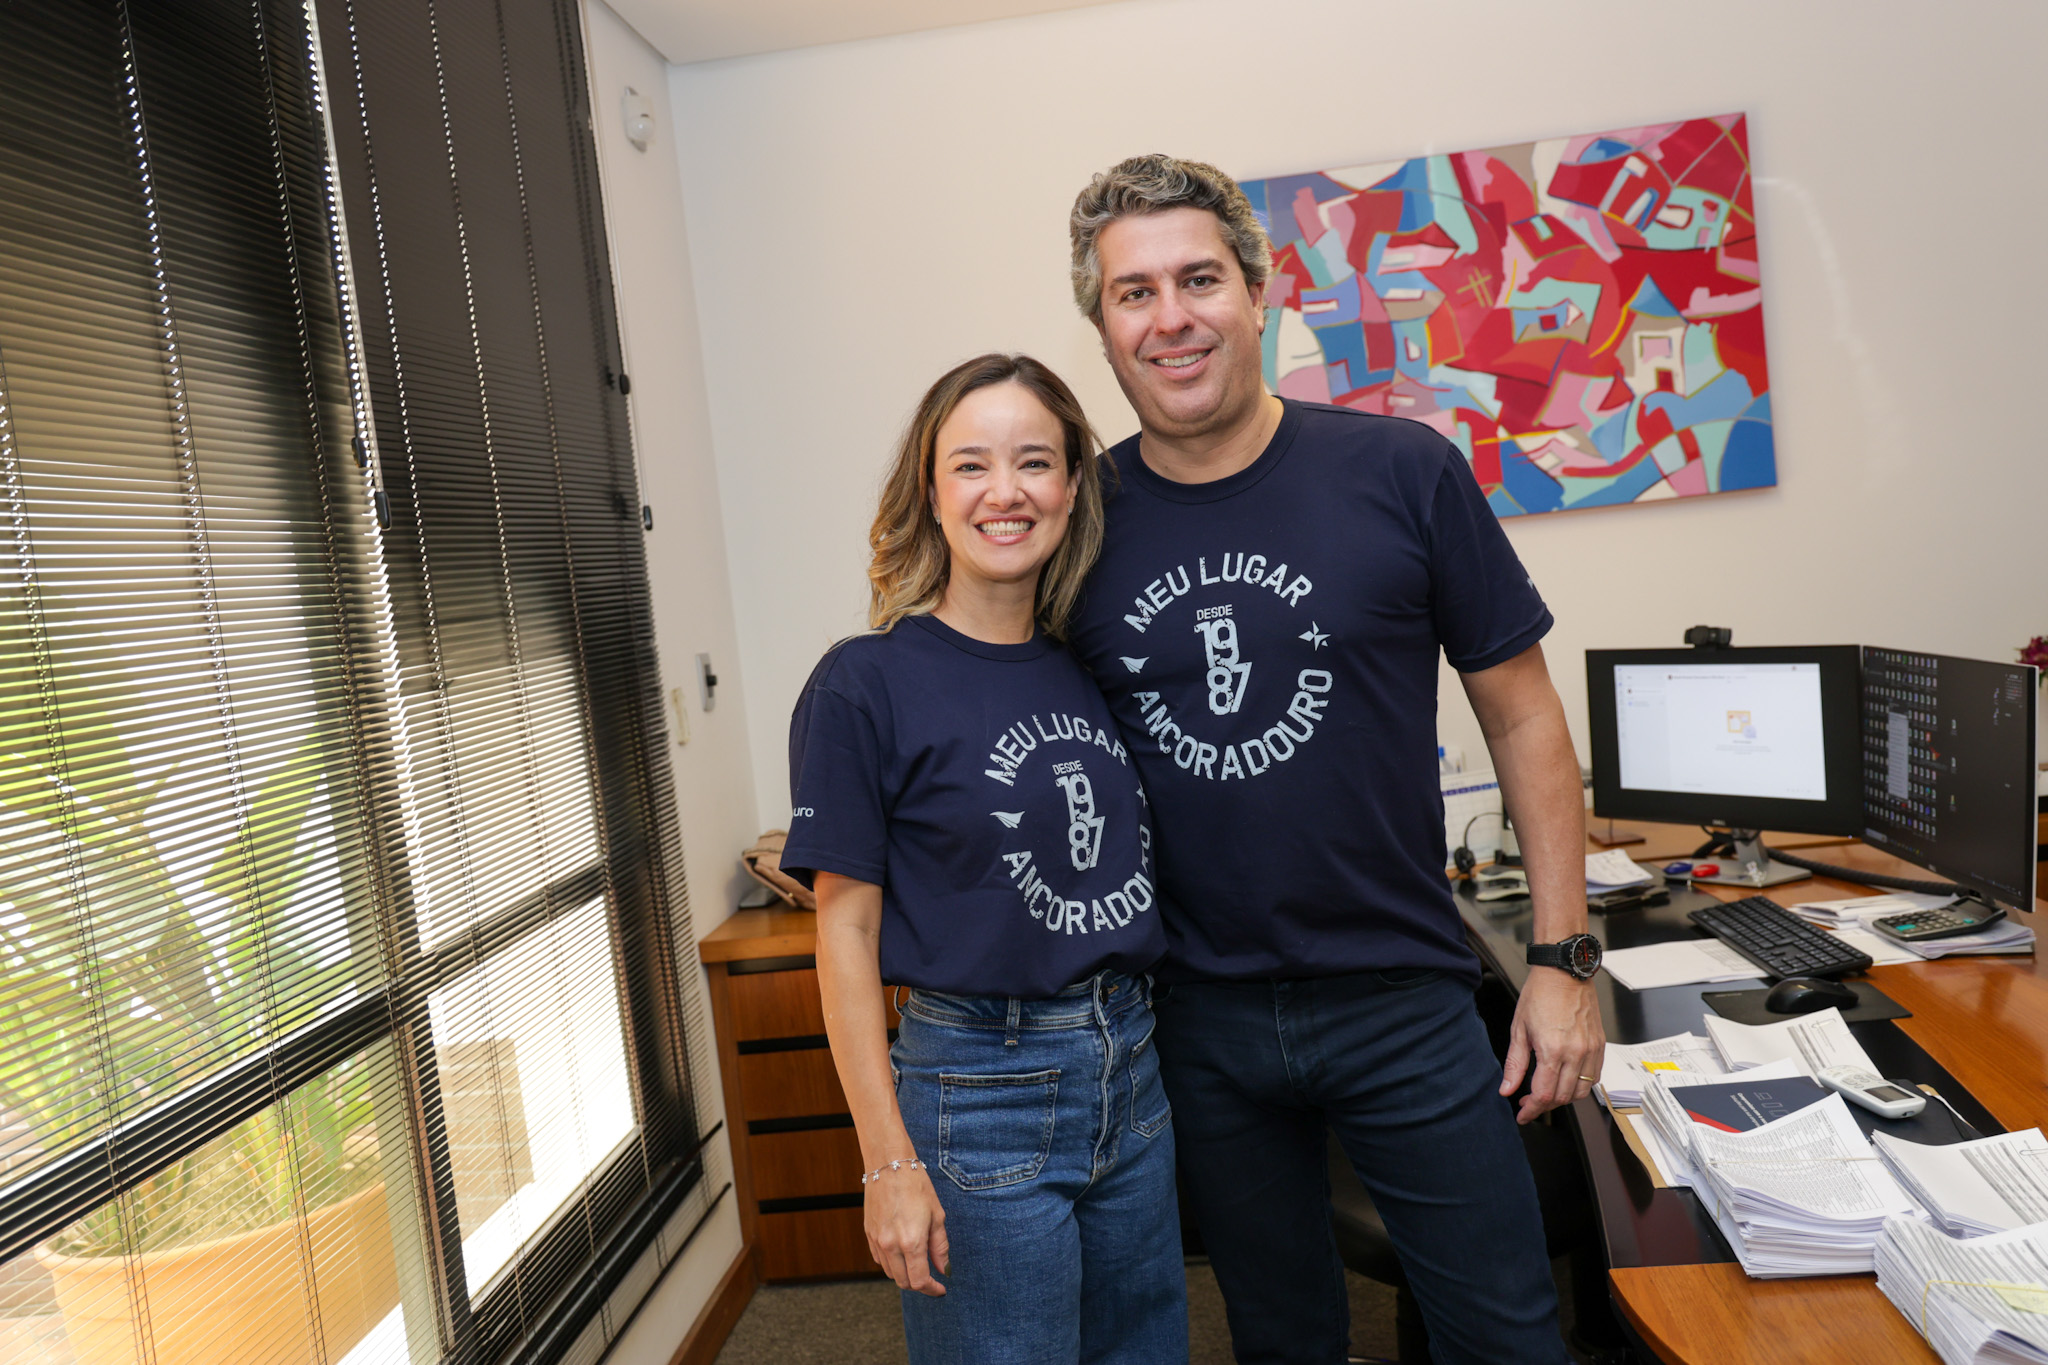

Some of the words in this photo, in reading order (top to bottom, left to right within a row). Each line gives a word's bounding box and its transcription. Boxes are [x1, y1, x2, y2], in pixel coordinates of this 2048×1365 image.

[1124, 564, 1191, 634] MEU
[1198, 552, 1313, 608] LUGAR
[1196, 604, 1233, 621] DESDE
[984, 720, 1042, 787] MEU
[1032, 712, 1127, 766] LUGAR
[1132, 668, 1333, 781] ANCORADOURO
[1052, 760, 1084, 776] DESDE
